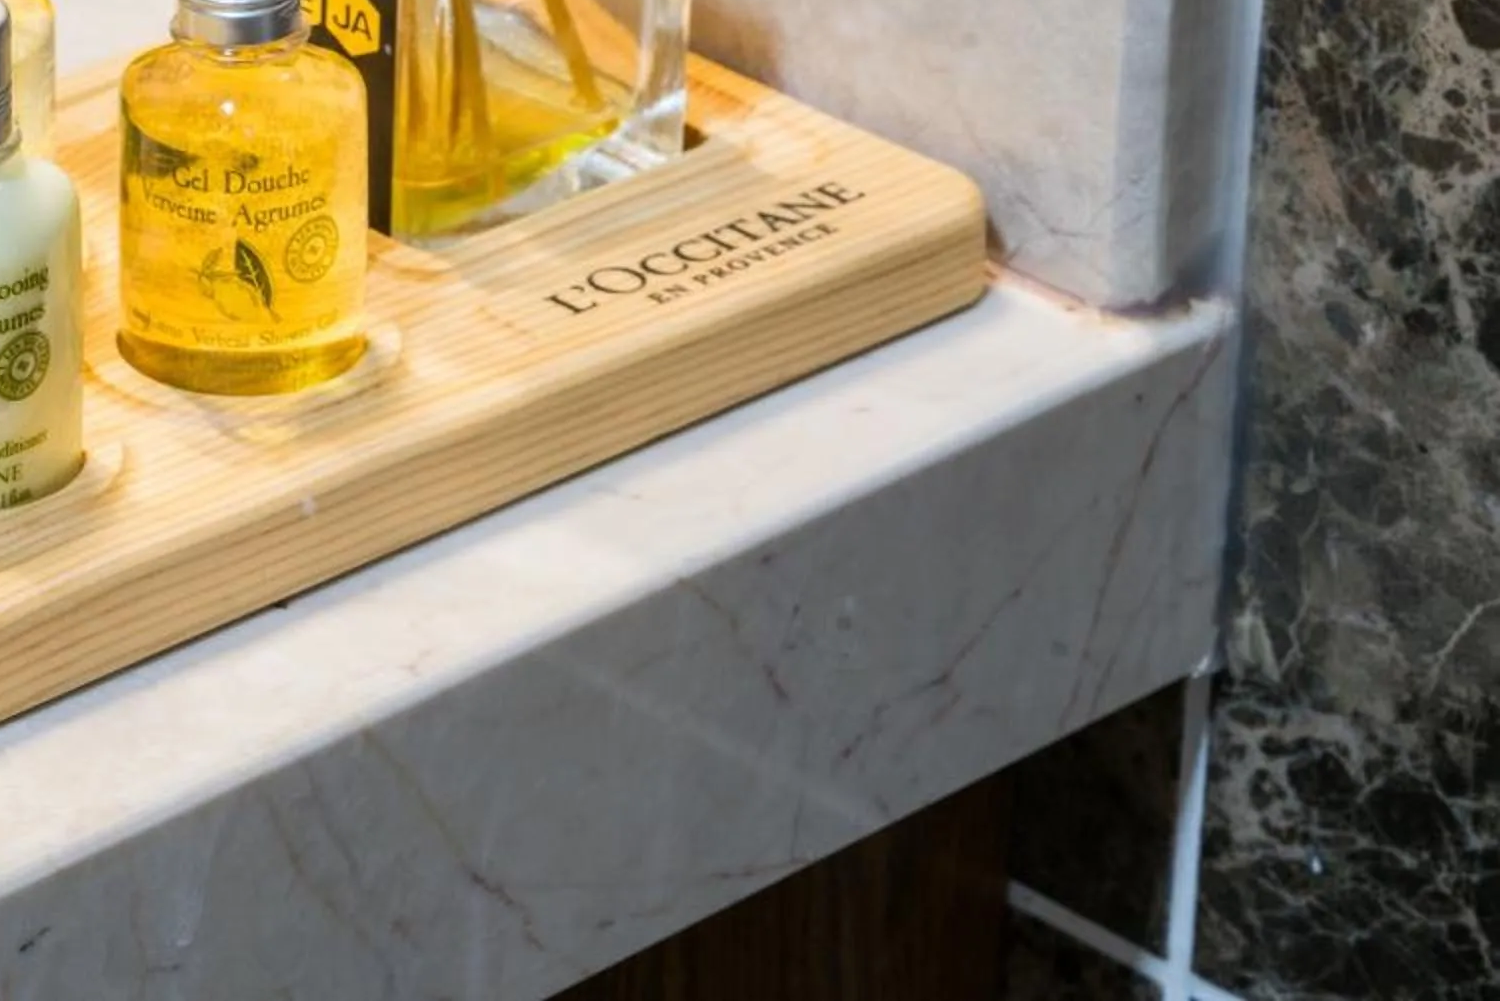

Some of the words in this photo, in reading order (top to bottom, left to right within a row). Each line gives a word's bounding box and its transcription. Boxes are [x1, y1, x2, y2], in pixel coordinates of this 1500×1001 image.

[332, 3, 373, 42] JA
[171, 166, 210, 192] Gel
[223, 163, 311, 195] Douche
[231, 195, 327, 233] Agrumes
[544, 180, 867, 315] L'OCCITANE
[647, 284, 688, 306] EN
[692, 222, 840, 287] PROVENCE
